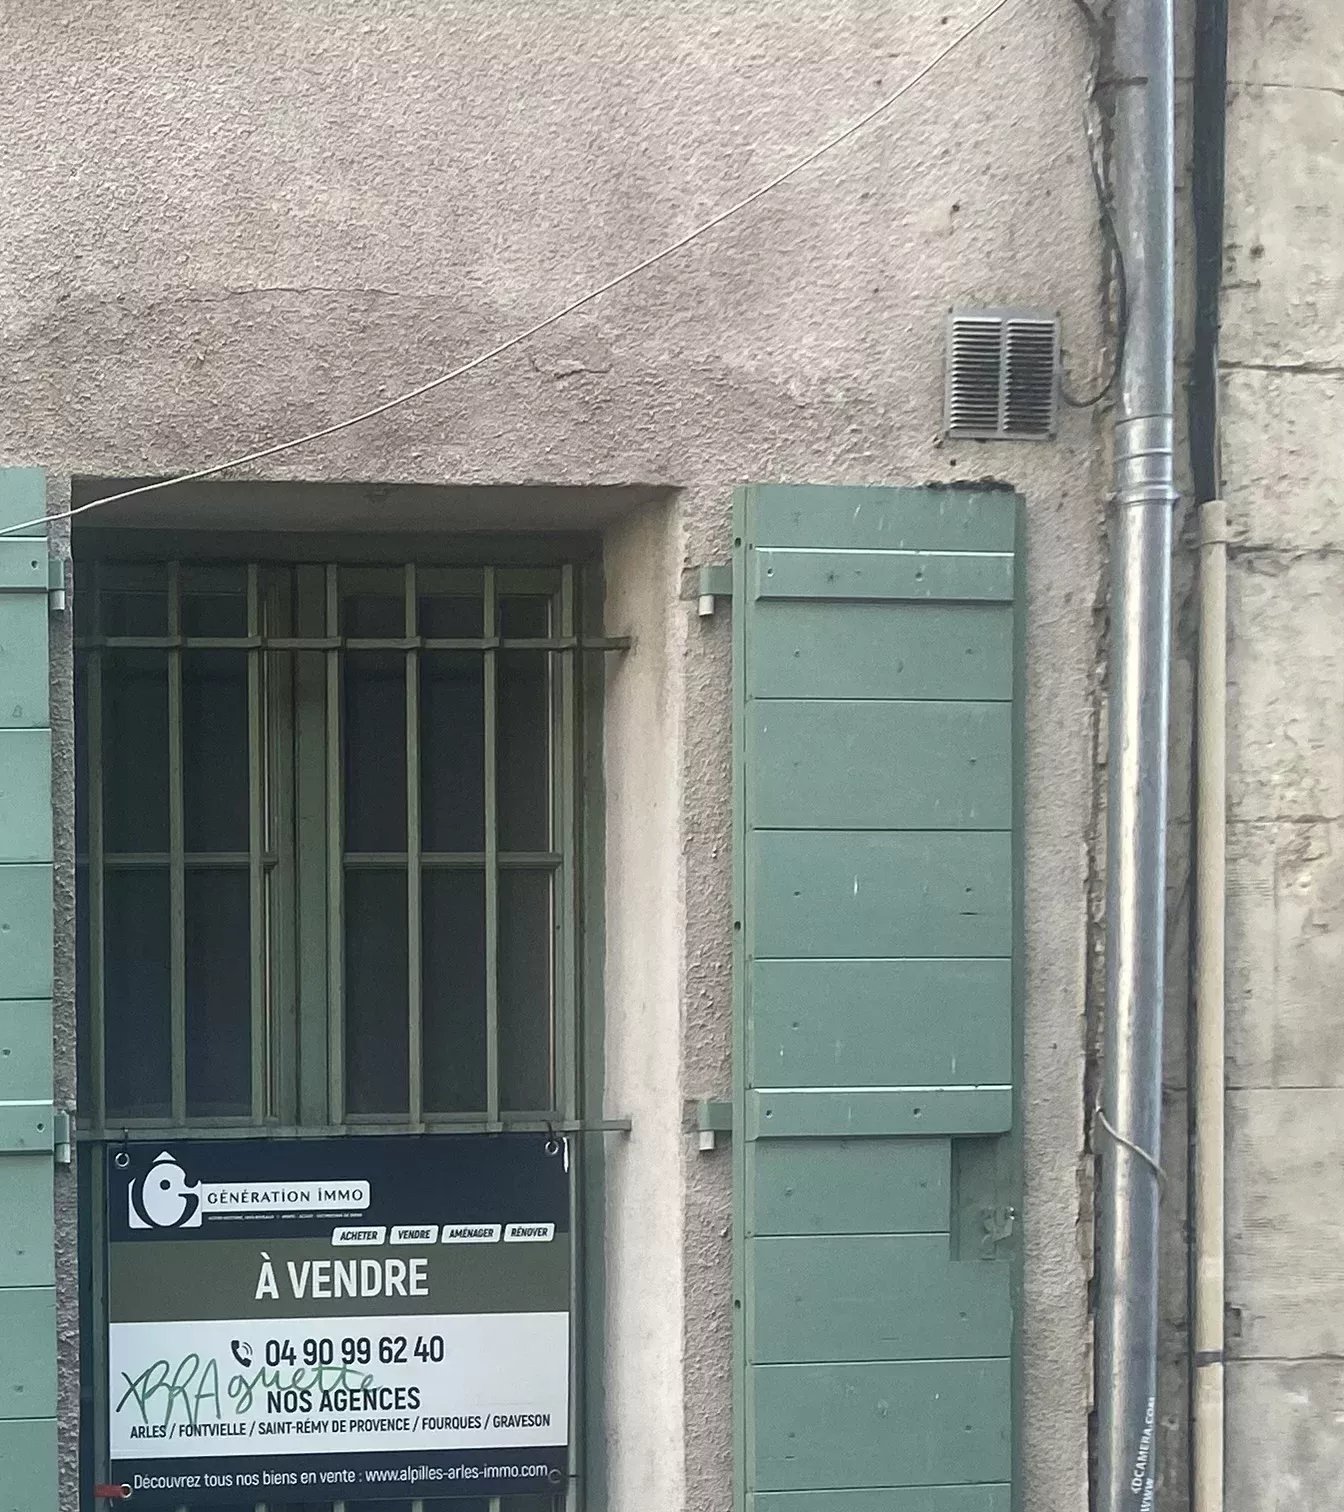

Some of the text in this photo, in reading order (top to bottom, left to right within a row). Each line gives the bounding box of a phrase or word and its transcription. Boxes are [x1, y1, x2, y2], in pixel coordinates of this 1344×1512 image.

[317, 1187, 364, 1202] IMMO
[339, 1230, 379, 1241] ACHETER
[397, 1229, 431, 1240] VENDRE
[254, 1252, 429, 1300] À VENDRE
[265, 1335, 444, 1367] 04 90 99 62 40
[267, 1386, 421, 1414] NOS AGENCES
[130, 1424, 167, 1439] ARLES
[178, 1422, 247, 1438] FONTVIELLE
[258, 1418, 329, 1435] SAINT-RÉMY
[331, 1419, 346, 1434] DE
[349, 1418, 410, 1433] PROVENCE
[421, 1415, 482, 1431] FOURQUES
[492, 1413, 551, 1429] GRAVESON
[133, 1473, 202, 1489] Découvrez
[204, 1473, 233, 1487] tous
[236, 1473, 260, 1486] nos
[262, 1469, 297, 1485] biens
[299, 1472, 317, 1485] en
[319, 1469, 356, 1484] vente
[364, 1462, 548, 1484] www.alpilles-arles-immo.com
